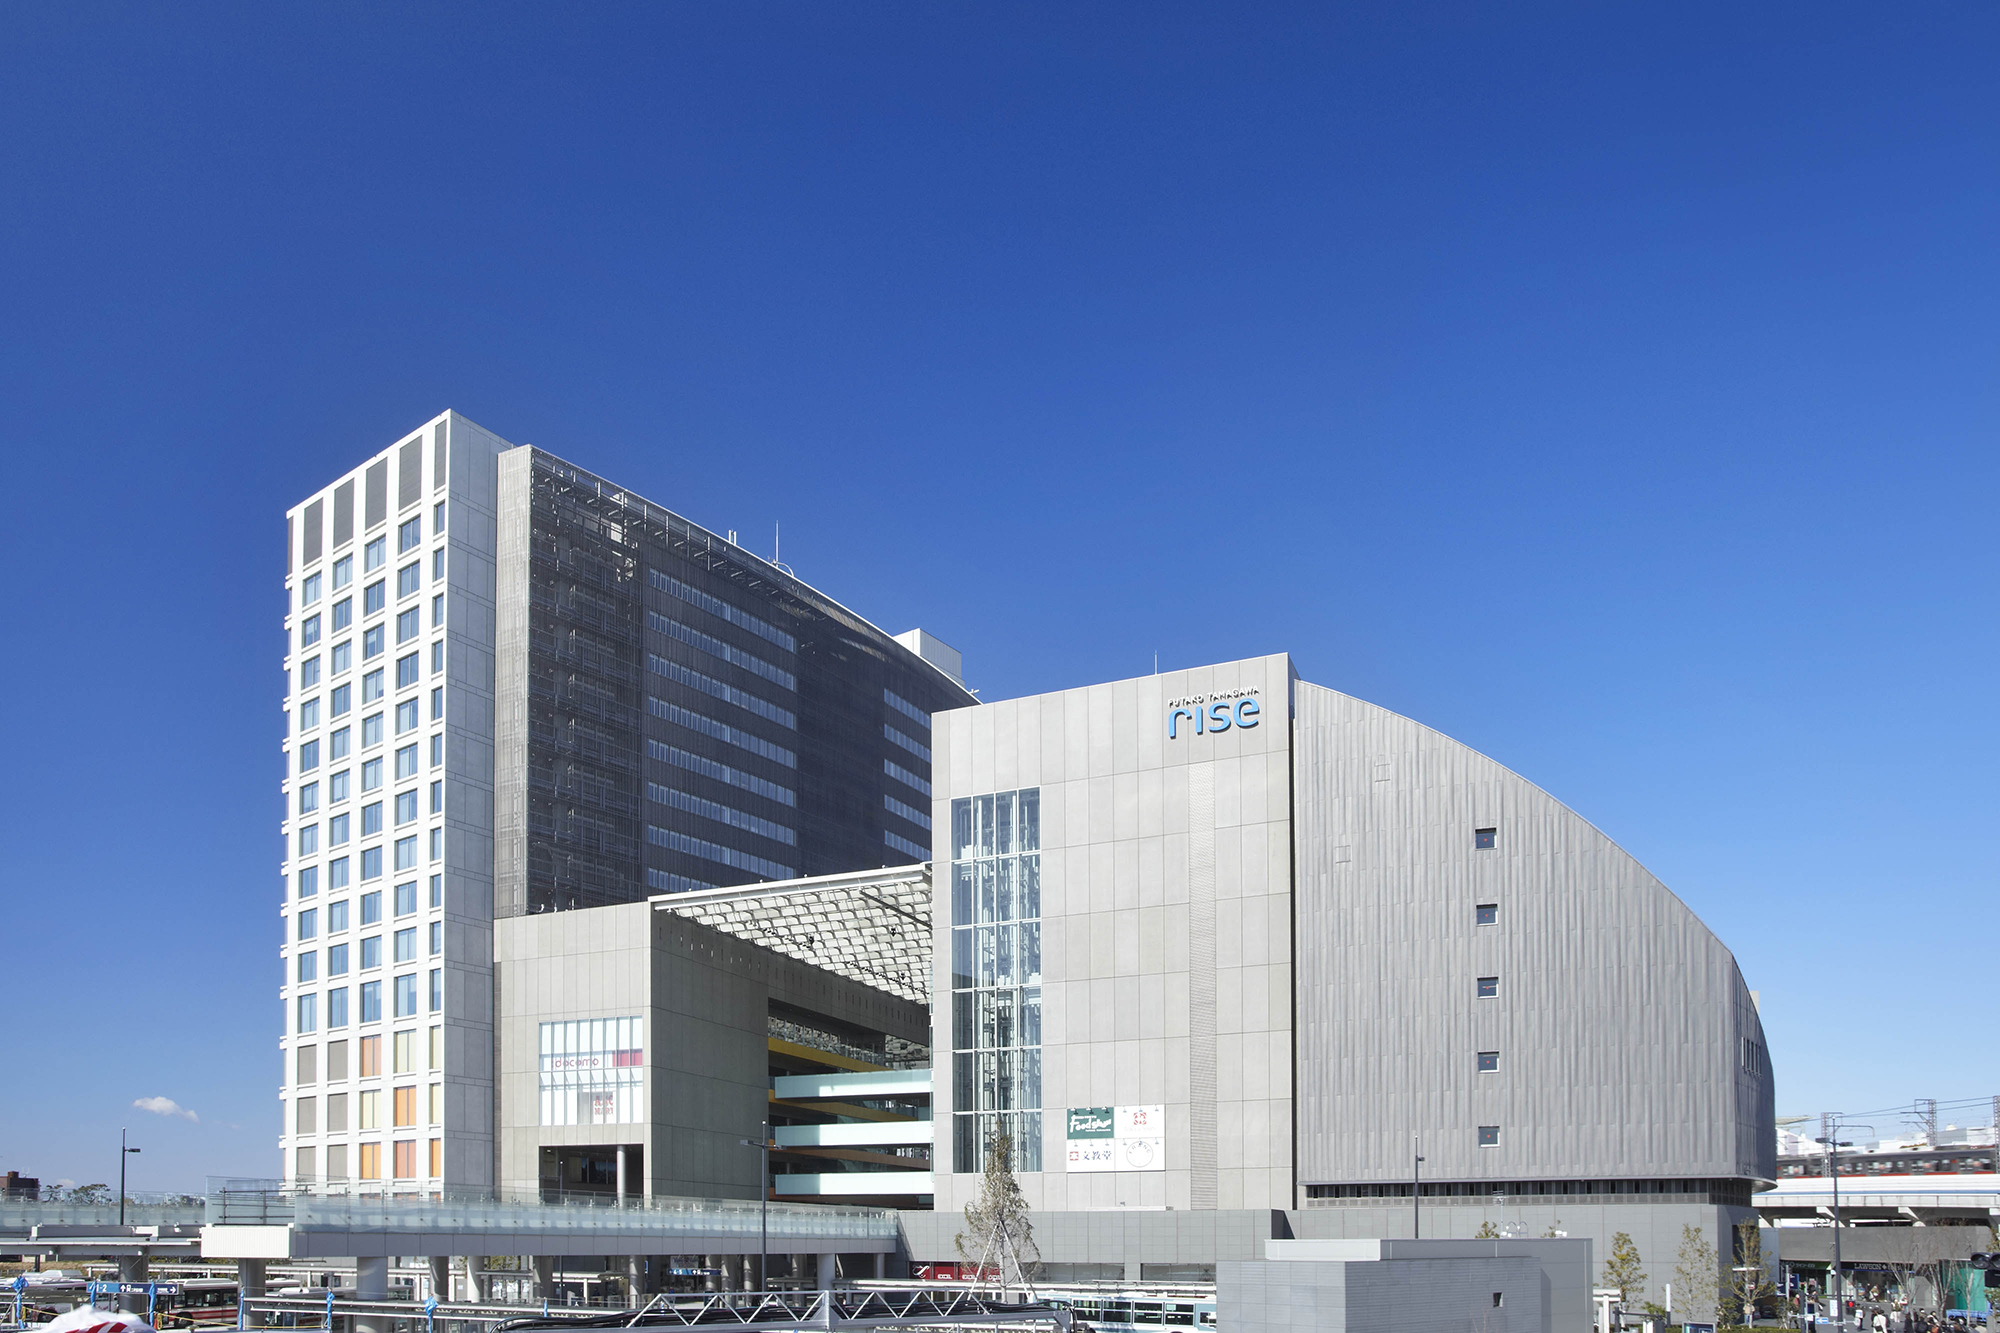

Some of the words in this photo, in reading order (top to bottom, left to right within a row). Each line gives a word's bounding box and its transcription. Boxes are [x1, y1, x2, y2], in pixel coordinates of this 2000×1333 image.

[1168, 694, 1204, 708] FUTAKO
[1207, 685, 1260, 702] TAMAGAWA
[1168, 697, 1260, 740] rise
[555, 1056, 599, 1068] docomo
